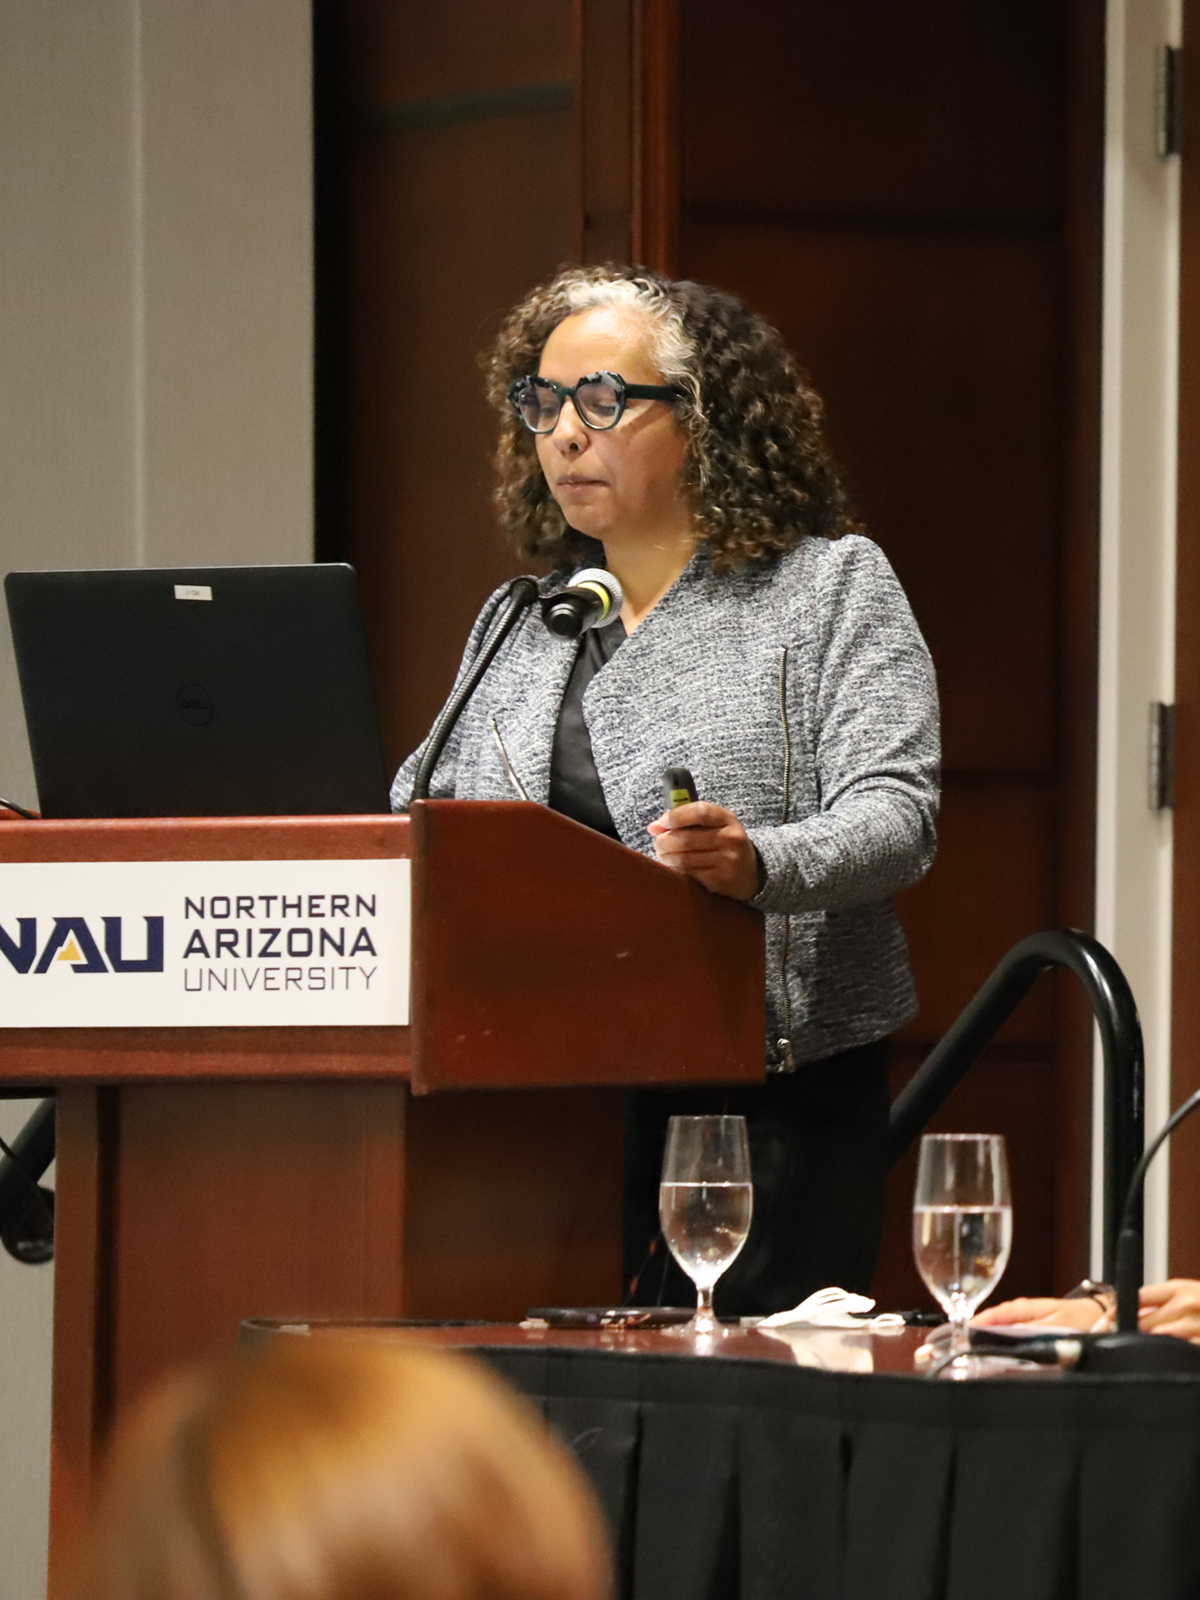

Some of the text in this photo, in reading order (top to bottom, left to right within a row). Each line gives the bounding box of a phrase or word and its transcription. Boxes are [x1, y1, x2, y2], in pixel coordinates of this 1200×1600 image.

[184, 894, 377, 919] NORTHERN
[183, 926, 377, 959] ARIZONA
[184, 966, 378, 992] UNIVERSITY
